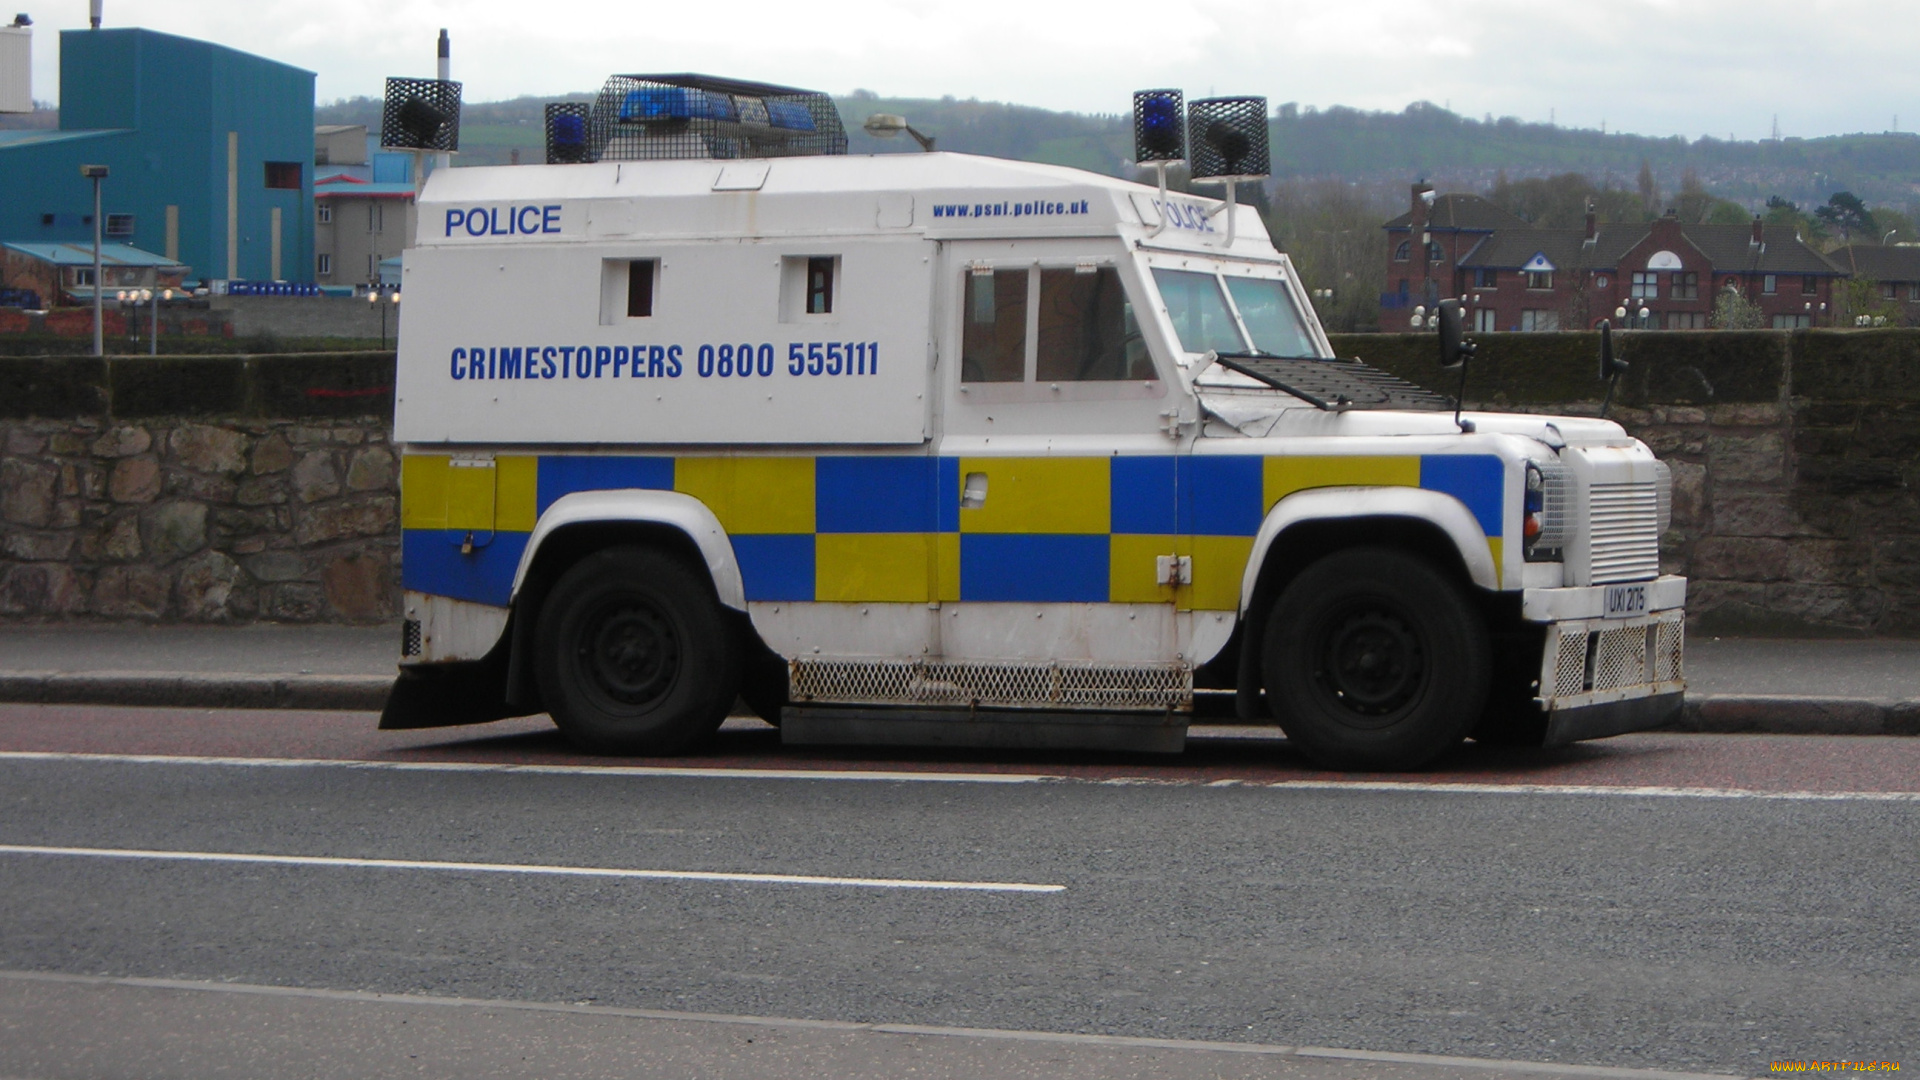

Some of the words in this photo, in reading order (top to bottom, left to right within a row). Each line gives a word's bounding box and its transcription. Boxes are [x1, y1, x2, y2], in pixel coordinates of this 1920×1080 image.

[446, 205, 562, 236] POLICE
[933, 200, 1089, 218] www.psni.police.uk
[450, 345, 683, 380] CRIMESTOPPERS
[697, 343, 775, 378] 0800
[788, 342, 879, 376] 555111
[1610, 587, 1625, 612] UXI
